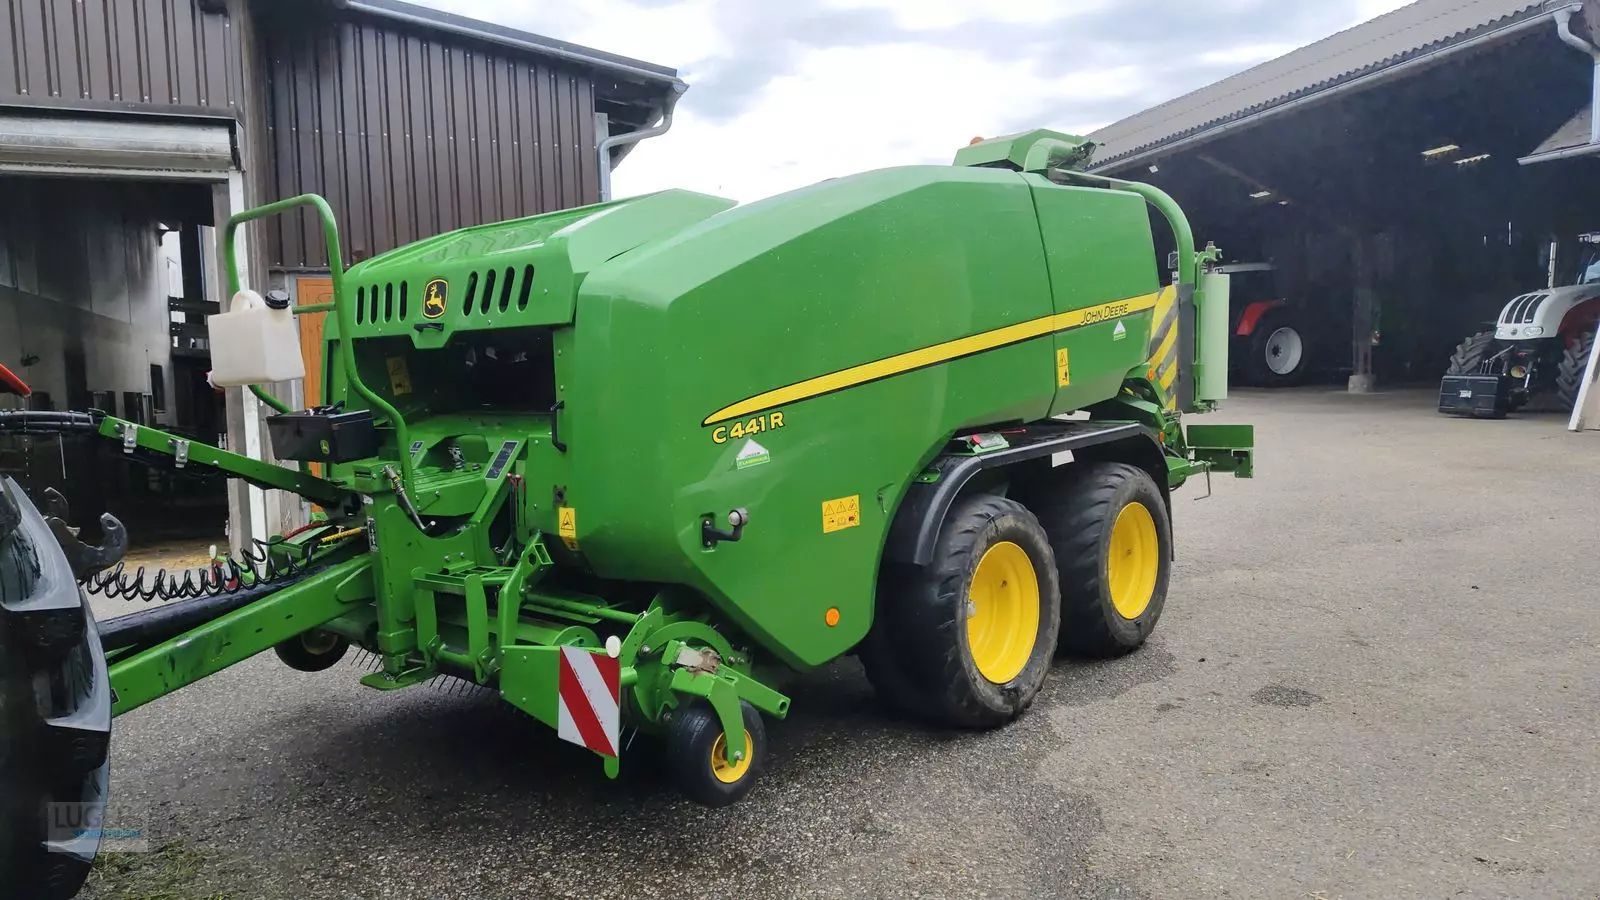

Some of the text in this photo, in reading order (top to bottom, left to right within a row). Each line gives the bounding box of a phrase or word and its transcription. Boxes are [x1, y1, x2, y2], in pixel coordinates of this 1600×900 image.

[1080, 303, 1128, 325] JOHN DEERE
[712, 411, 785, 444] C 441 R
